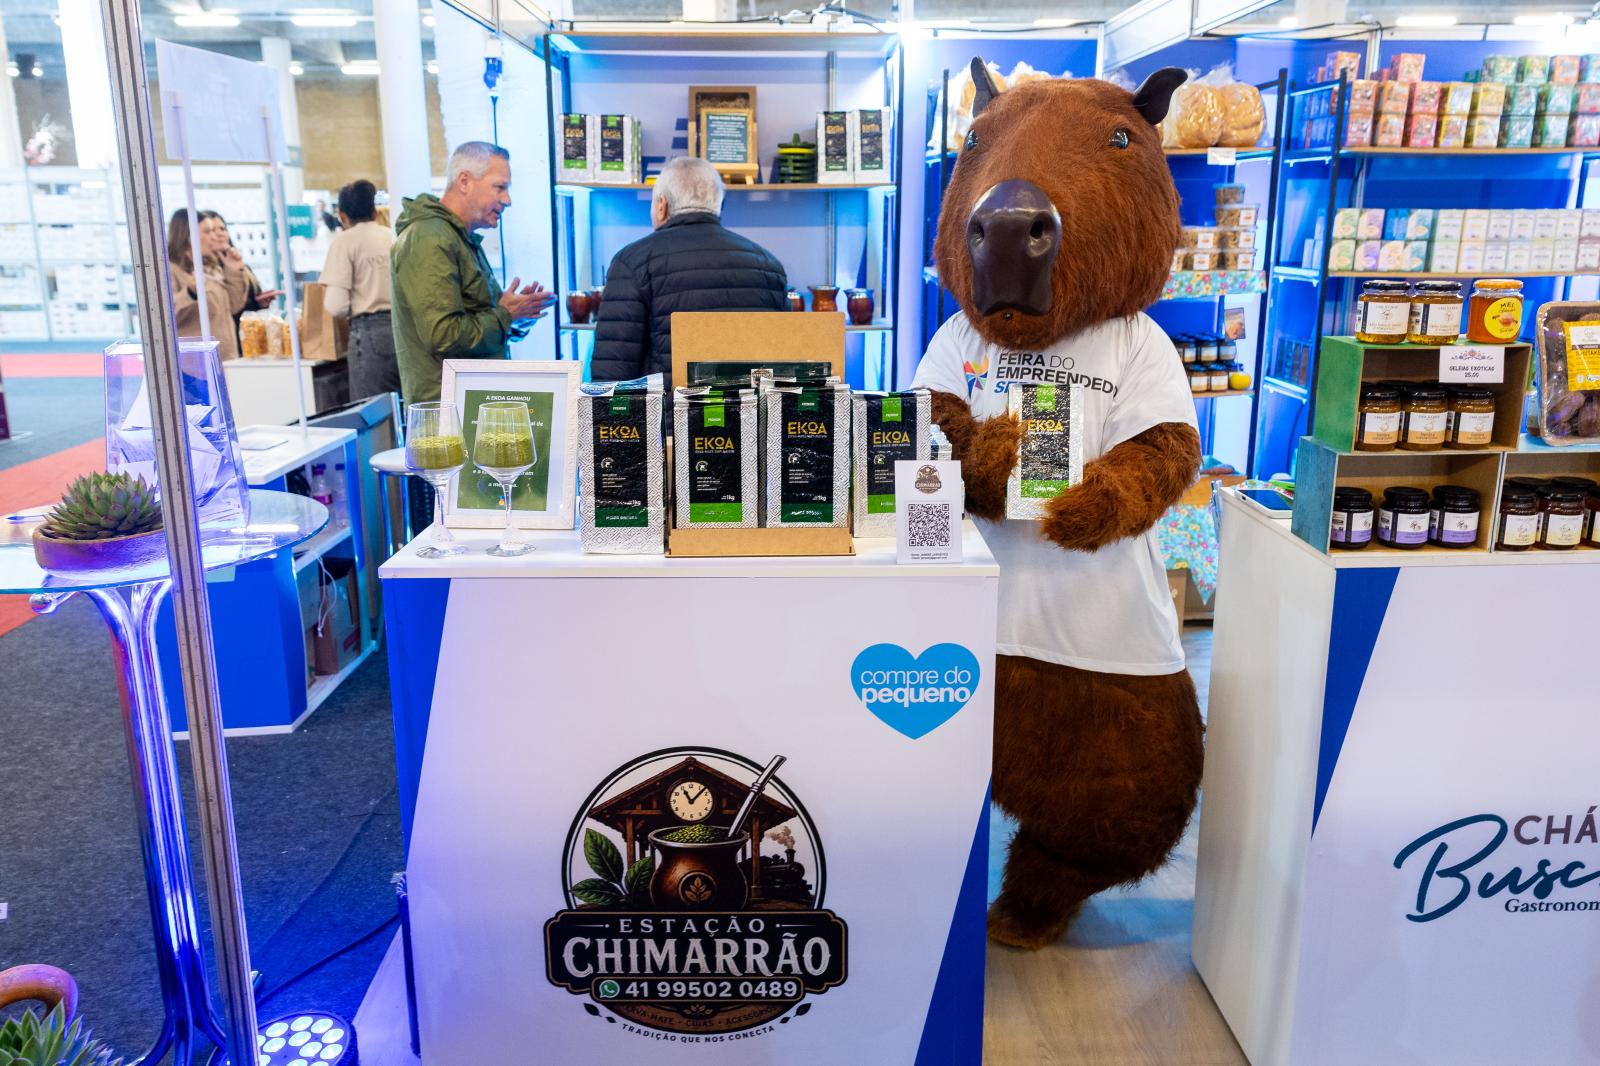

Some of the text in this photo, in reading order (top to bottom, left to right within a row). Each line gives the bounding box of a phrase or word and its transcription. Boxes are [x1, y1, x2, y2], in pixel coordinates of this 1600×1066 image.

[998, 353, 1075, 370] FEIRA DO
[599, 425, 640, 439] EKOA
[787, 421, 828, 435] EKOA
[1027, 419, 1064, 432] EKOA
[694, 436, 735, 450] EKOA
[872, 430, 911, 444] EKOA
[860, 665, 972, 688] compre do
[861, 686, 972, 708] pequeno
[1513, 805, 1599, 845] CHÁ
[1393, 813, 1600, 923] Busc
[618, 915, 766, 937] ESTAÇÃO
[562, 932, 832, 978] CHIMARRÃO
[625, 981, 798, 998] 41 99502 0489
[621, 1022, 775, 1044] TRADIÇÃO QUE NOS CONECTA
